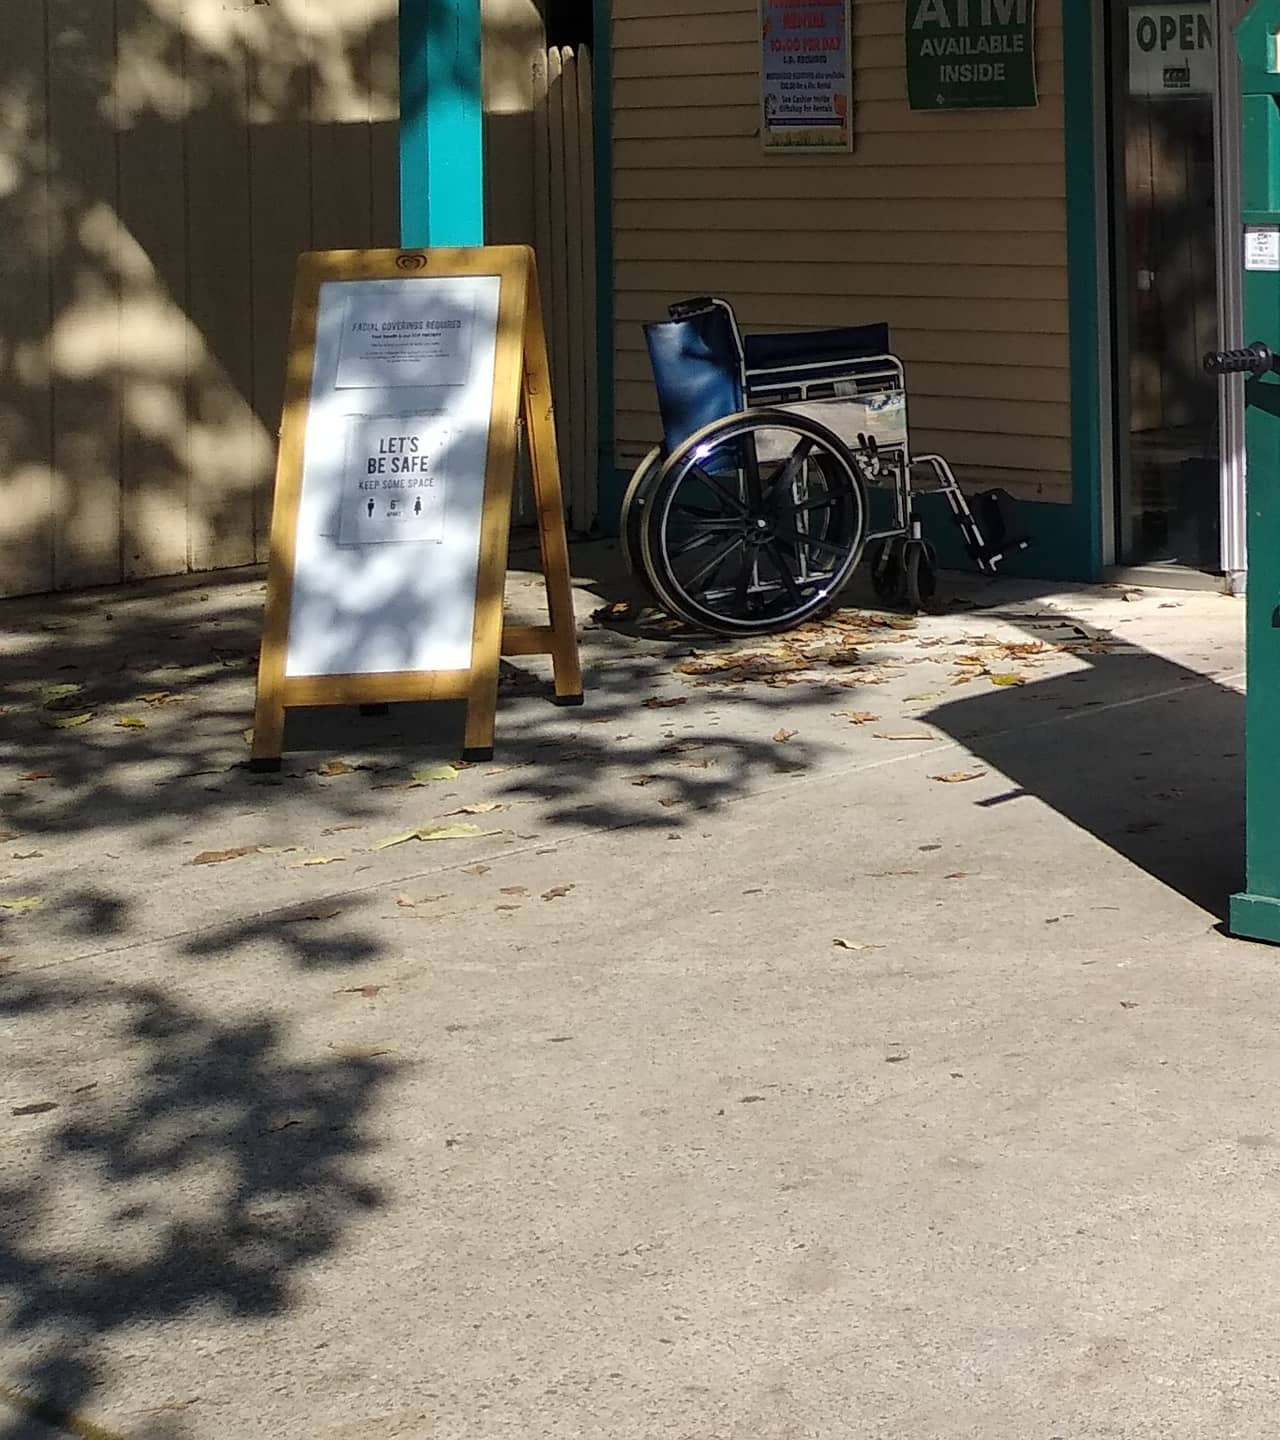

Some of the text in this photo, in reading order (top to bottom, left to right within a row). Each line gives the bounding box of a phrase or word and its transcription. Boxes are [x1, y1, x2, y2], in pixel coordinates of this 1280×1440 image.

[1136, 14, 1213, 52] OPEN
[920, 35, 1024, 57] AVAILABLE
[940, 63, 1005, 82] INSIDE
[379, 436, 420, 454] LET'S
[367, 455, 429, 474] BE SAFE
[359, 477, 434, 490] KEEP SOME SPACE
